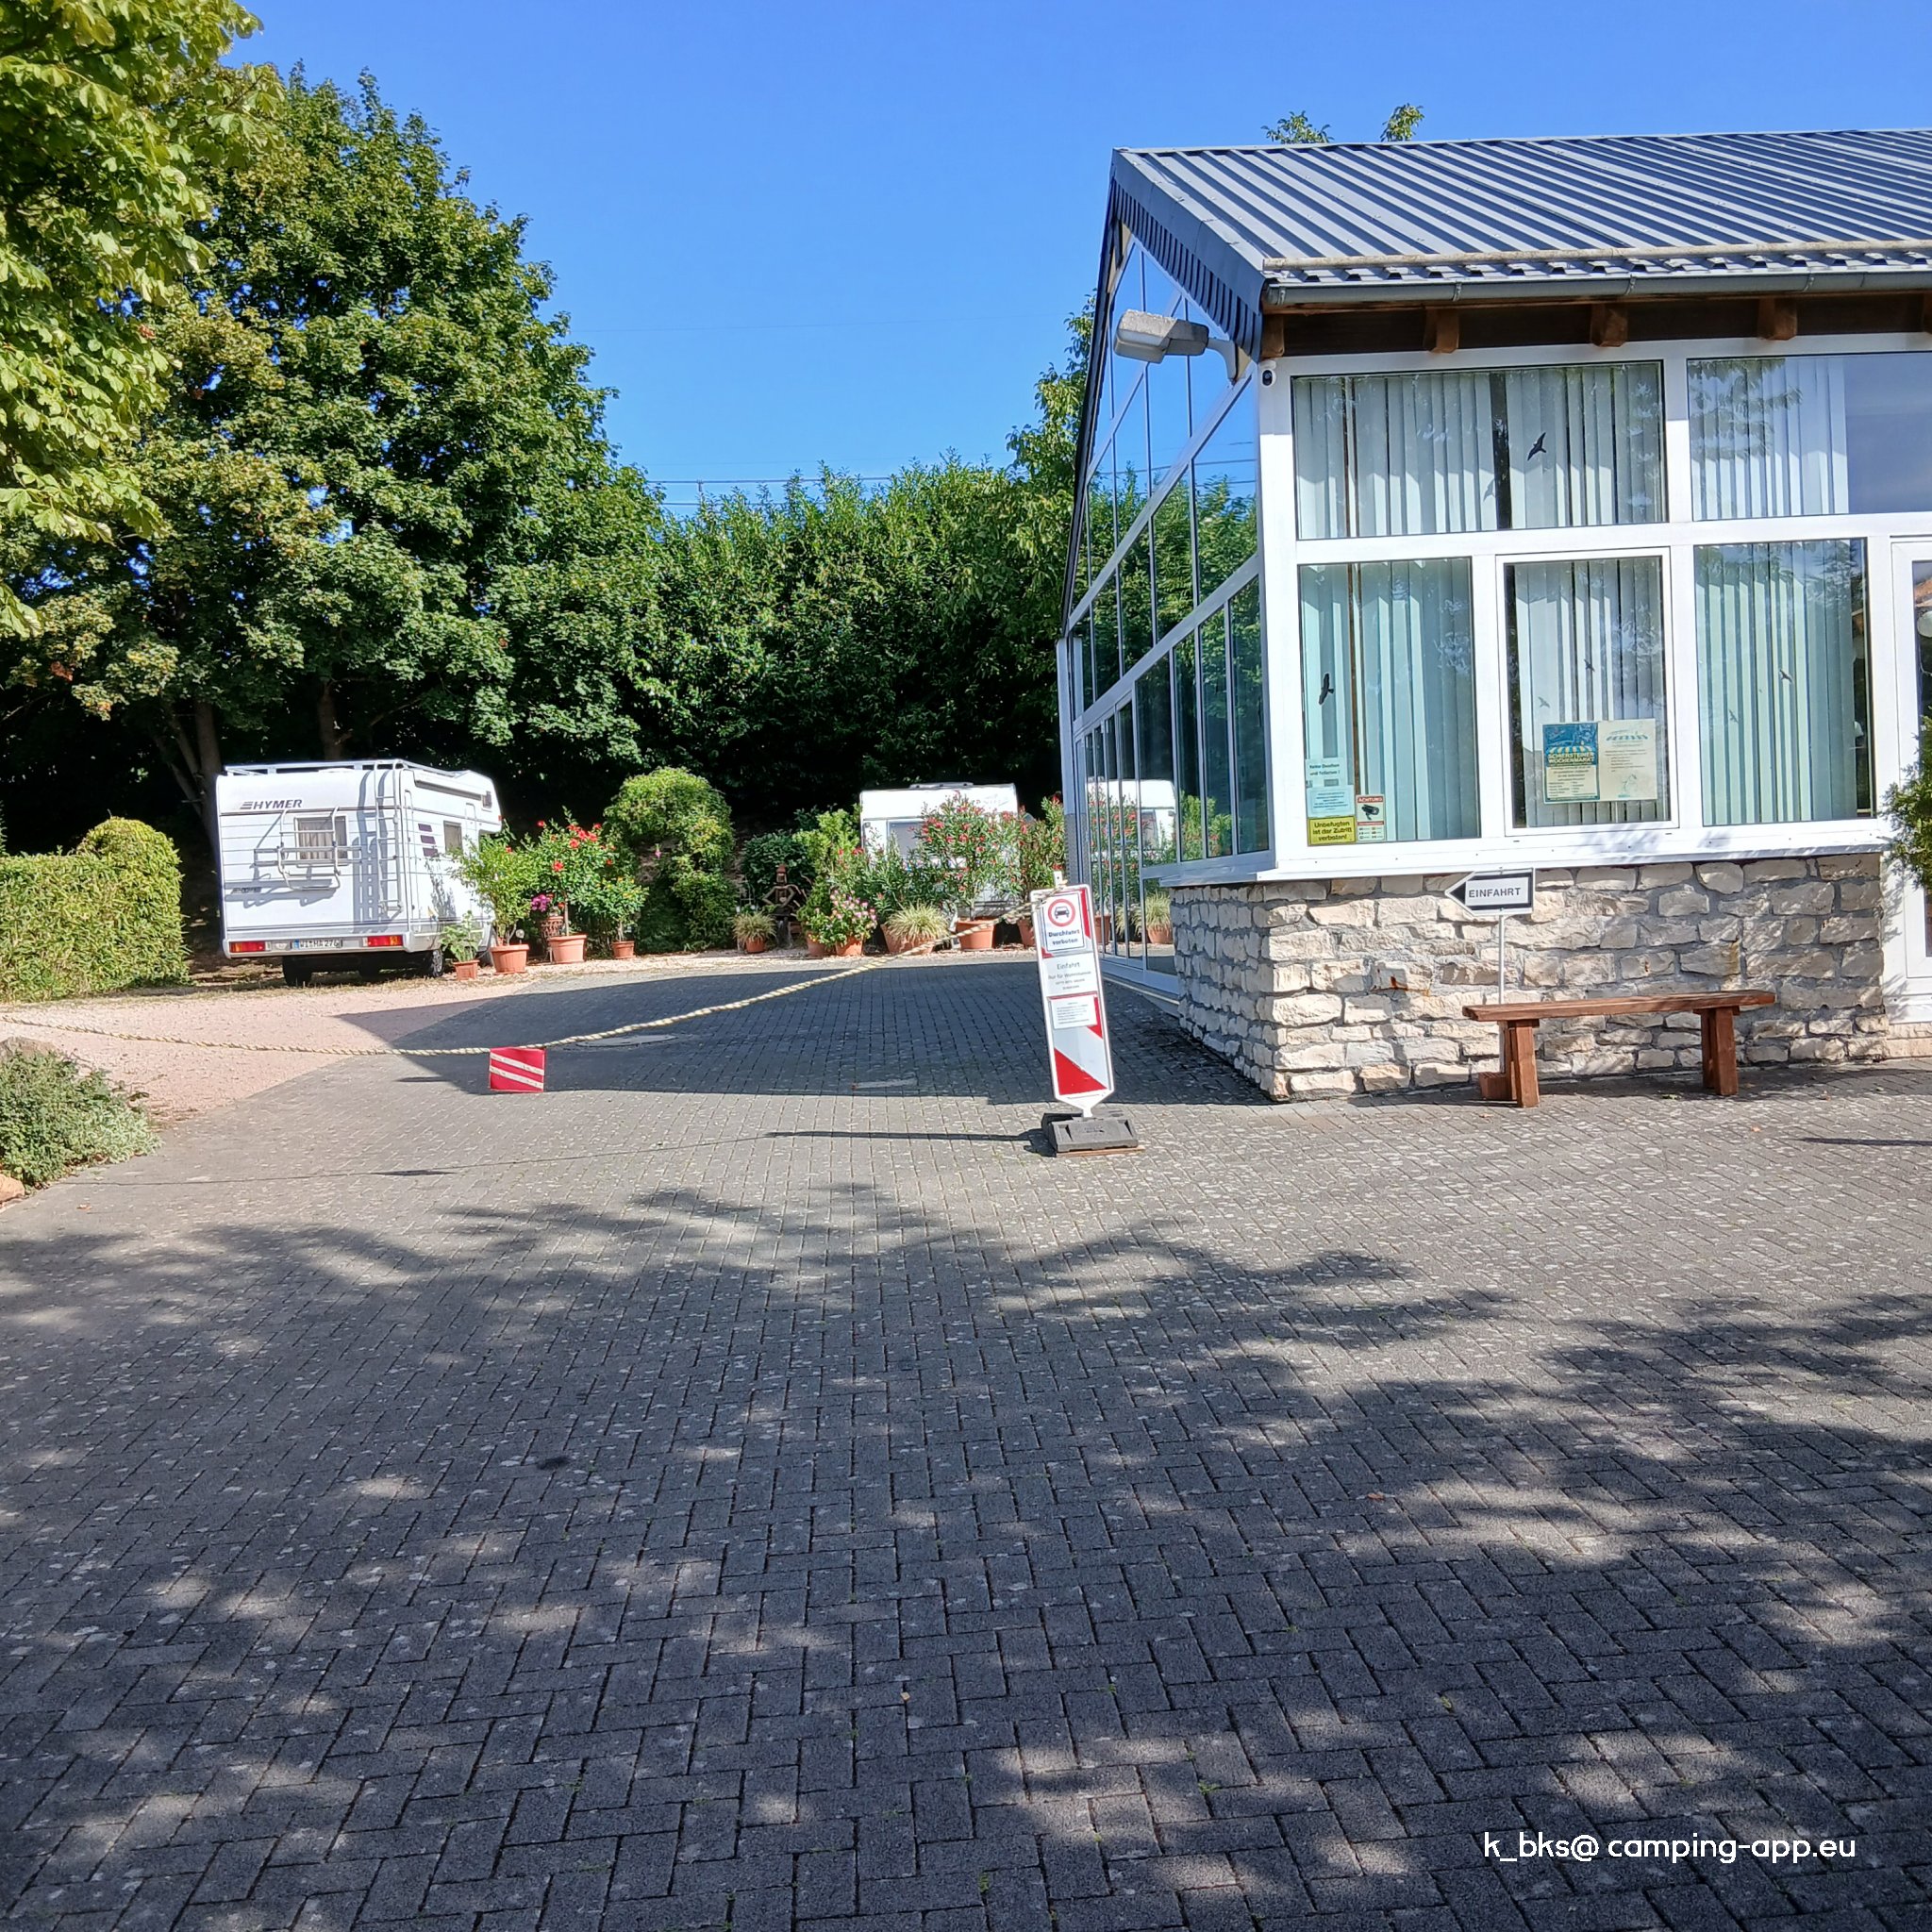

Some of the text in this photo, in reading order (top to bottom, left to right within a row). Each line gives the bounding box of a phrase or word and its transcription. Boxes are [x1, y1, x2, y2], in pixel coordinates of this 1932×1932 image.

[253, 799, 303, 809] HYMER
[1468, 887, 1522, 898] EINFAHRT
[1057, 961, 1080, 970] Einfahrt
